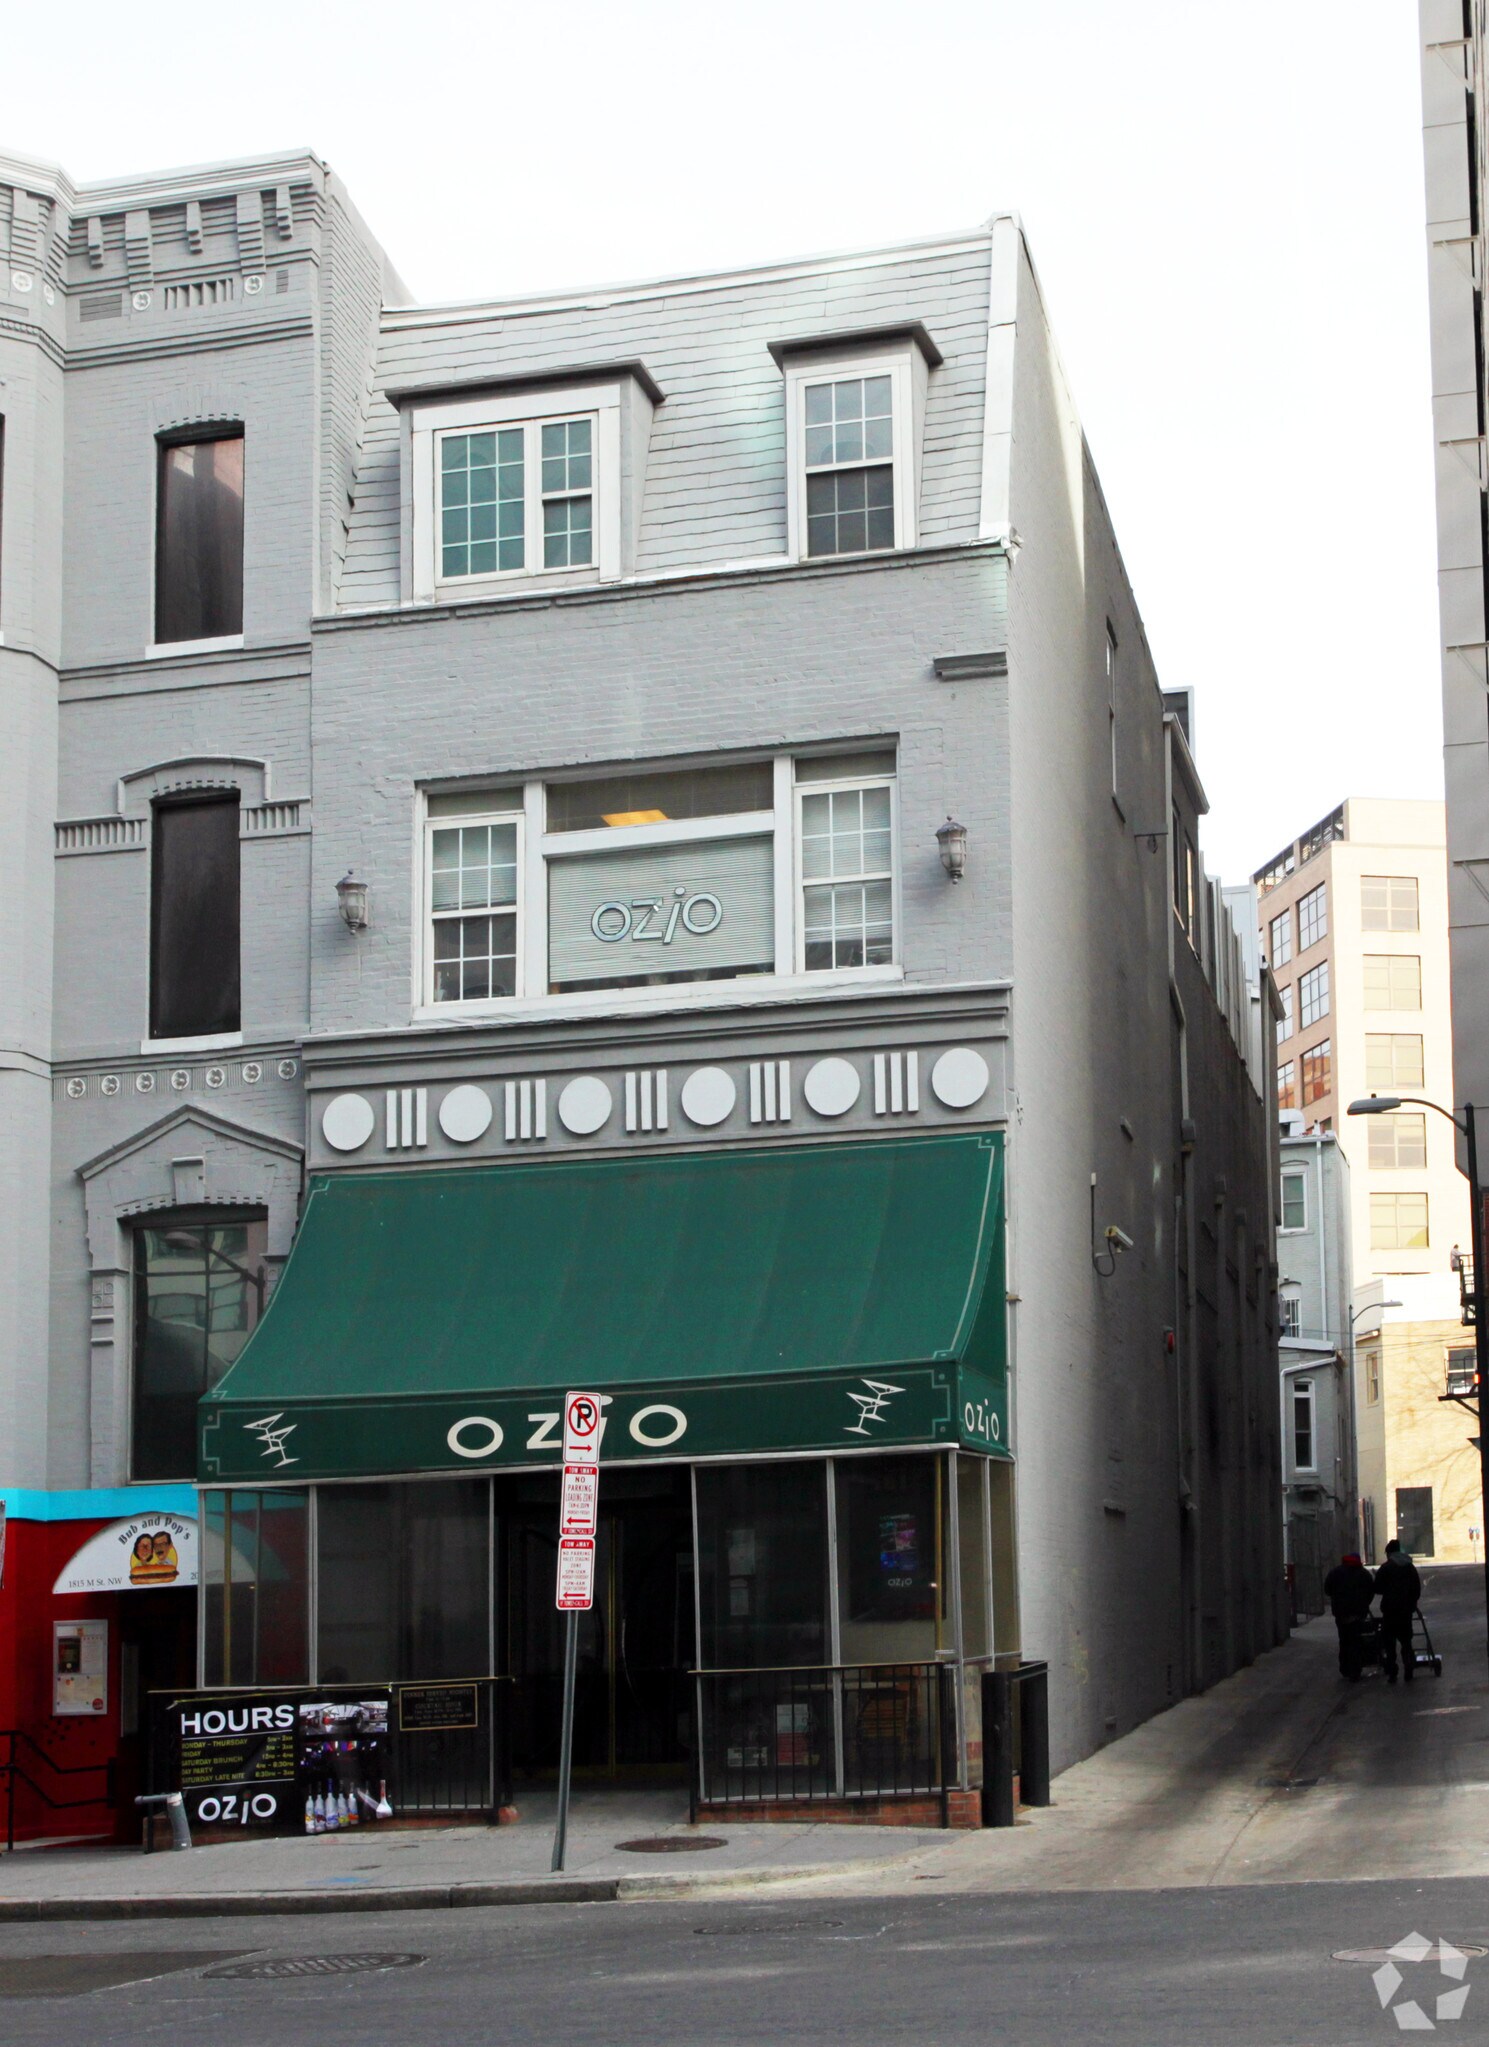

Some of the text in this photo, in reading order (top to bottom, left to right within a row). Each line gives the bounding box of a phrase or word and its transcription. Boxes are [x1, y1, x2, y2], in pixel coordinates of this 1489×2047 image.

[568, 1484, 592, 1492] PARKING
[566, 1493, 594, 1502] LOADING ZONE
[118, 1515, 191, 1545] Bub and Pop's
[69, 1579, 85, 1588] 1815
[86, 1579, 95, 1587] M
[107, 1576, 123, 1585] NW
[181, 1705, 295, 1734] HOURS
[213, 1738, 248, 1748] THURSDAY
[182, 1758, 212, 1766] SATURDAY
[213, 1755, 244, 1765] BRUNCH
[192, 1766, 214, 1775] PARTY
[182, 1775, 213, 1784] SATURDAY
[215, 1773, 231, 1781] LATE
[231, 1772, 246, 1780] NITE
